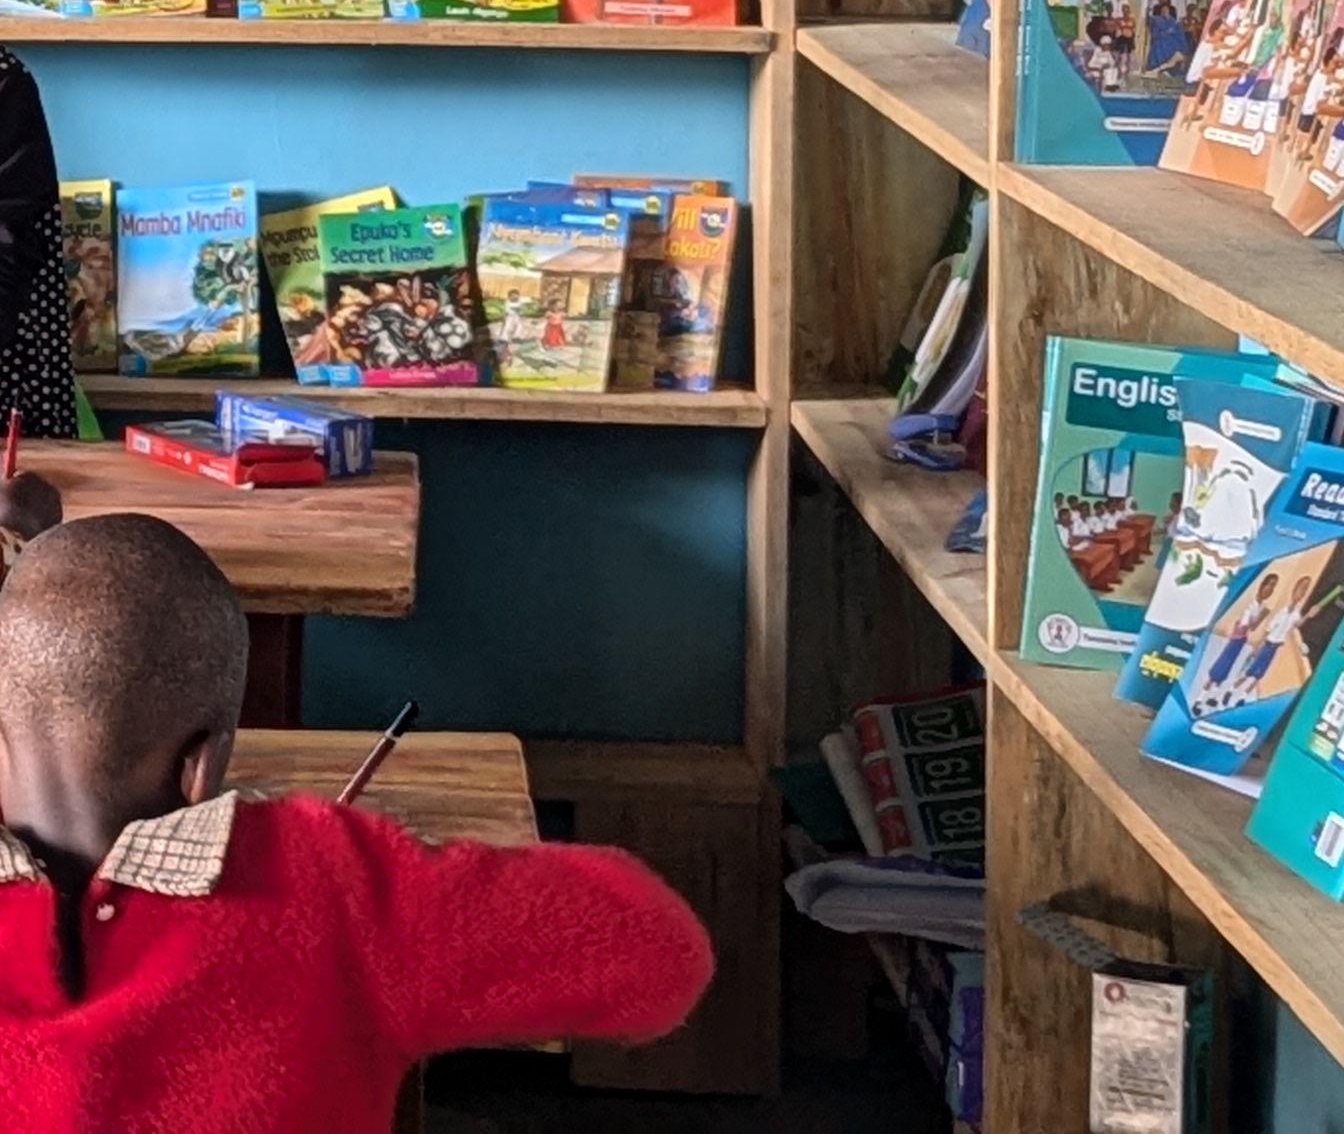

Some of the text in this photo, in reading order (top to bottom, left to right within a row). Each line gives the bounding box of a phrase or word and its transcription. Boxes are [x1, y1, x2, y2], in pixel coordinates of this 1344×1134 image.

[121, 207, 247, 238] Mamba Mnafiki
[330, 245, 434, 264] Secret Home
[1073, 367, 1178, 408] Englis
[911, 709, 958, 743] 20
[925, 756, 972, 792] 19
[938, 805, 982, 839] 18
